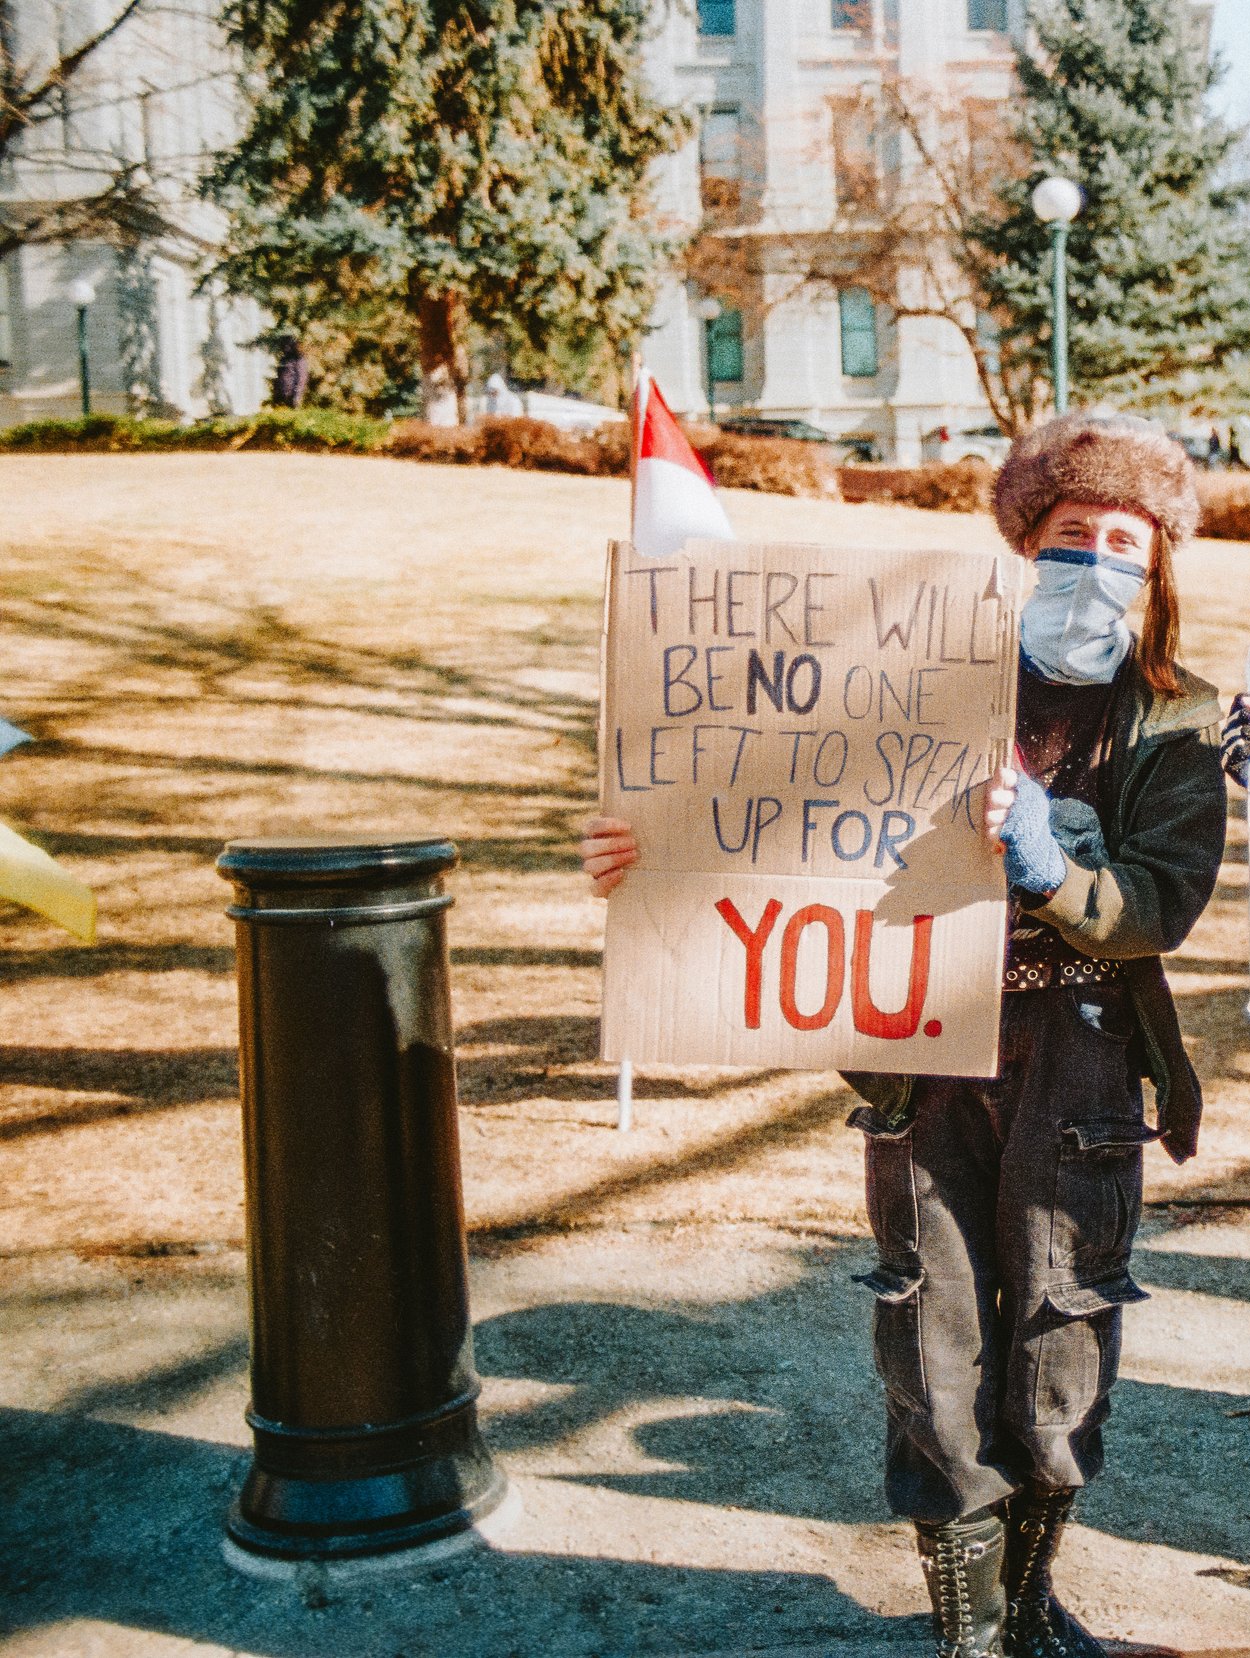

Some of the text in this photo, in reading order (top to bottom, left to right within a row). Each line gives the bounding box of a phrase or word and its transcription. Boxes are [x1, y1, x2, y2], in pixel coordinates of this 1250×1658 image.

[624, 567, 997, 666] THERE WILL
[663, 645, 948, 725] BE NO ONE
[616, 724, 993, 835] LEFT TO SPEAK
[712, 797, 916, 870] UP FOR
[714, 898, 942, 1039] YOU.
